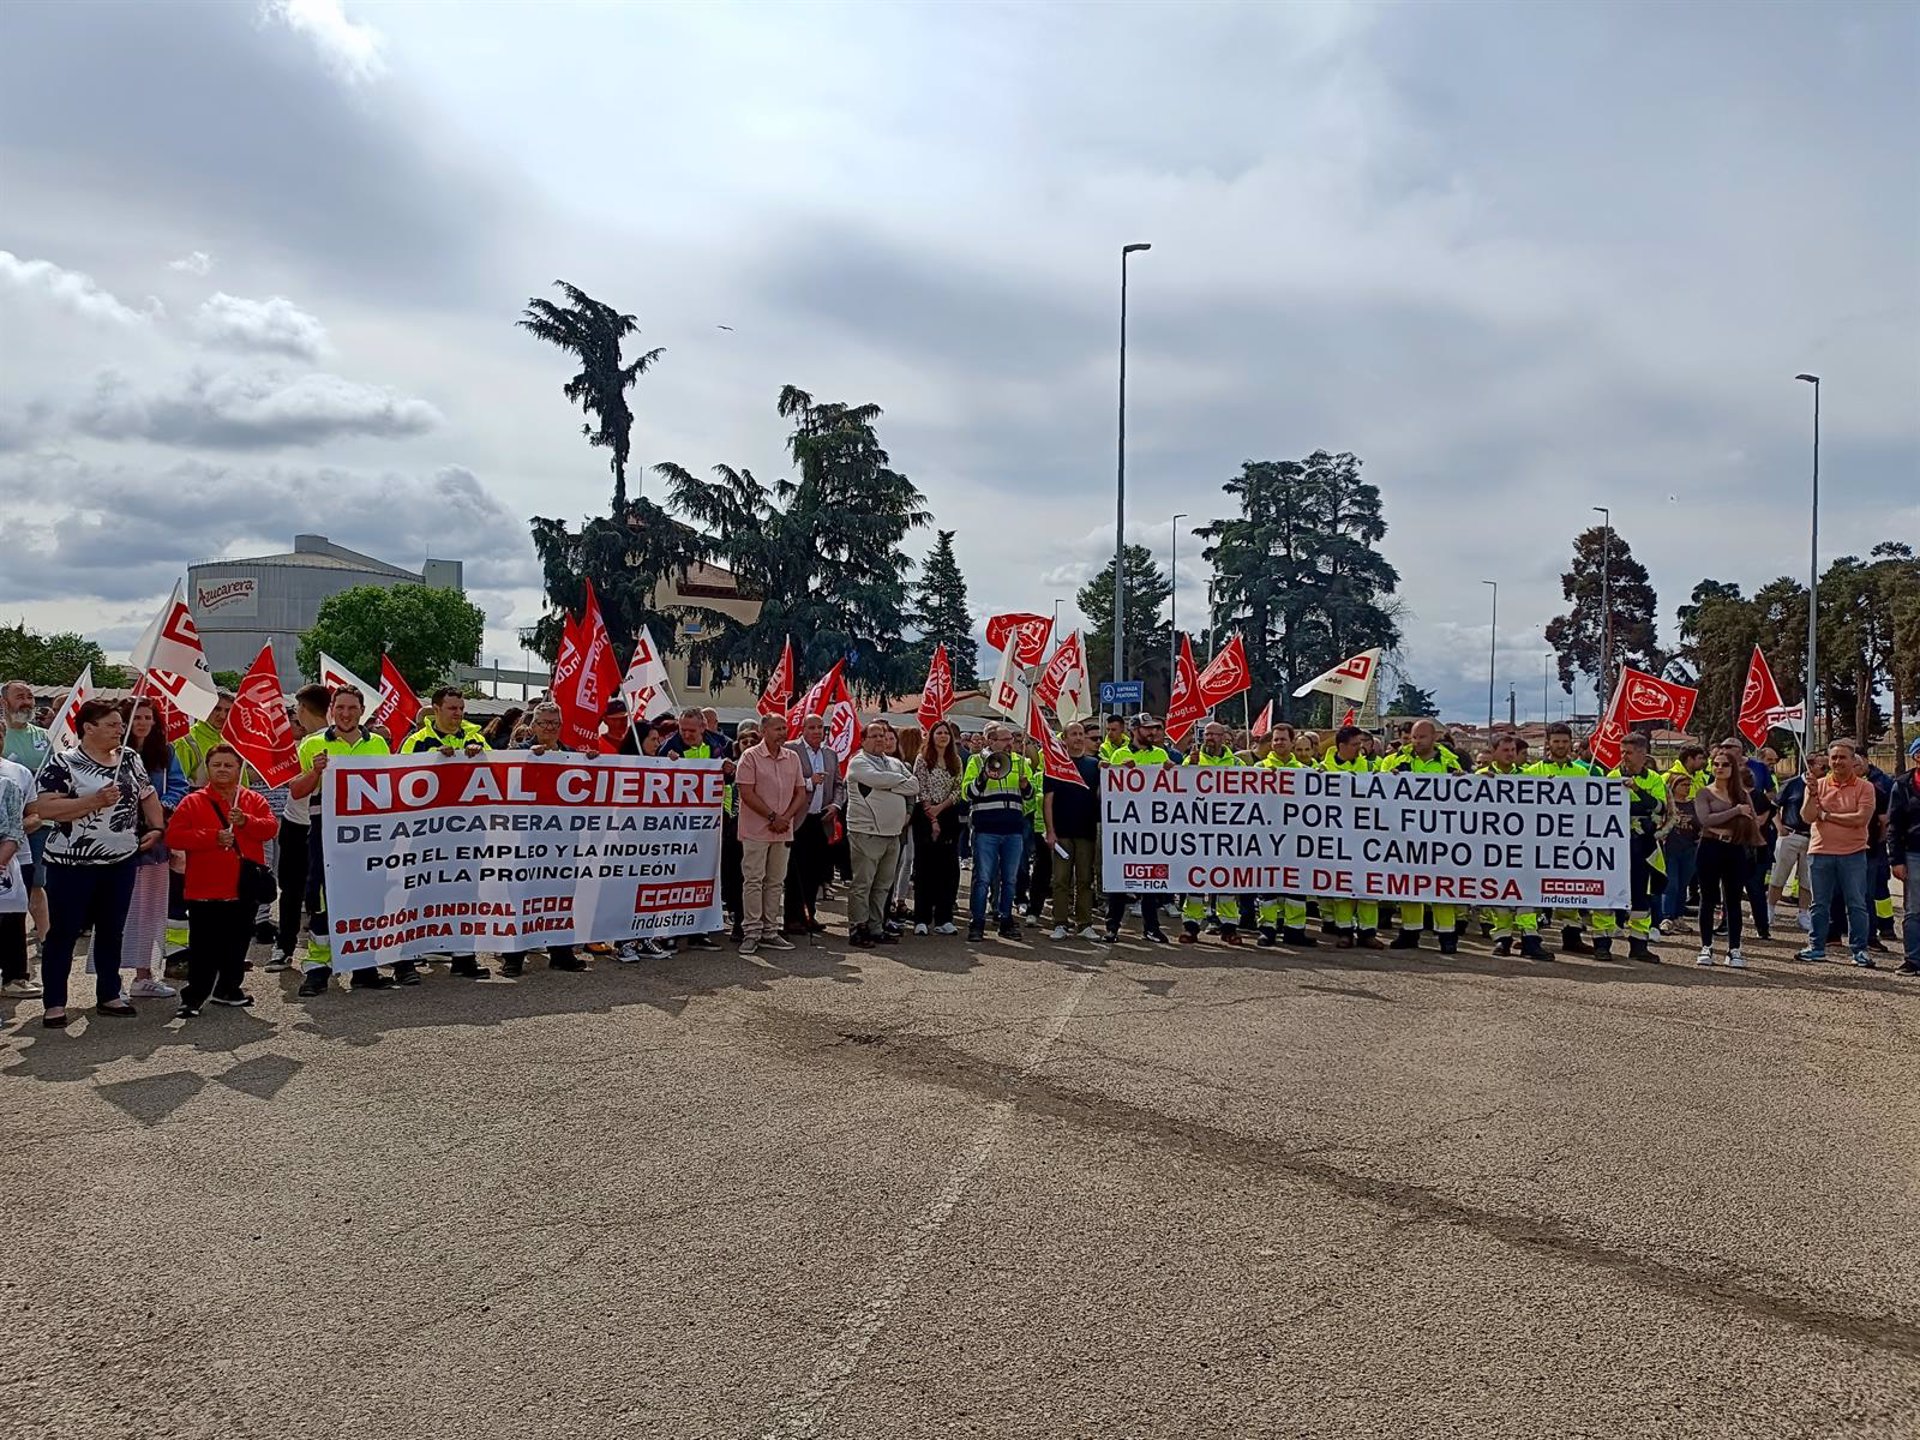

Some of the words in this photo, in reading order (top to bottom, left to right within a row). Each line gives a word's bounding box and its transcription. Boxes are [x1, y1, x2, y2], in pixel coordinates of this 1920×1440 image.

[197, 580, 254, 610] Azucarera
[245, 679, 292, 737] UGT
[347, 770, 440, 811] NO
[458, 767, 537, 802] AL
[556, 769, 724, 804] CIERRE
[1108, 768, 1146, 793] NO
[1152, 769, 1187, 793] AL
[1195, 770, 1296, 795] CIERRE
[1305, 772, 1341, 797] DE
[1351, 775, 1387, 799] LA
[1393, 777, 1576, 806] AZUCARERA
[1585, 781, 1622, 806] DE
[337, 824, 382, 844] DE
[389, 814, 563, 840] AZUCARERA
[570, 815, 601, 831] DE
[606, 815, 641, 831] LA
[642, 812, 721, 831] BAÑEZA
[1107, 800, 1141, 824] LA
[1151, 796, 1272, 826] BAÑEZA.
[1283, 802, 1343, 828] POR
[1354, 806, 1389, 831] EL
[1401, 808, 1525, 836] FUTURO
[1536, 813, 1574, 837] DE
[1585, 814, 1624, 838] LA
[366, 852, 416, 871] POR
[421, 847, 448, 864] EL
[455, 844, 548, 860] EMPLEO
[555, 844, 568, 858] Y
[573, 844, 598, 857] LA
[603, 843, 698, 857] INDUSTRIA
[1113, 832, 1262, 857] INDUSTRIA
[1269, 833, 1287, 856] Y
[1296, 834, 1352, 861] DEL
[1362, 838, 1472, 866] CAMPO
[1484, 843, 1523, 868] DE
[1535, 840, 1615, 871] LEÓN
[404, 871, 431, 889] EN
[438, 868, 472, 883] LA
[479, 866, 593, 882] PROVINCIA
[598, 865, 624, 877] DE
[628, 861, 676, 877] LEÓN
[1125, 865, 1153, 877] UGT
[1143, 880, 1168, 889] FICA
[1187, 866, 1300, 889] COMITE
[1313, 869, 1353, 892] DE
[1366, 872, 1523, 901] EMPRESA
[1544, 881, 1585, 892] CCOO
[640, 886, 695, 907] CCOO
[1541, 895, 1588, 904] industria
[335, 908, 418, 934] SECCIÓN
[423, 902, 516, 918] SINDICAL
[523, 896, 574, 915] CCOO
[631, 911, 695, 930] industria
[341, 922, 453, 955] AZUCARERA
[460, 922, 486, 936] DE
[493, 922, 517, 936] LA
